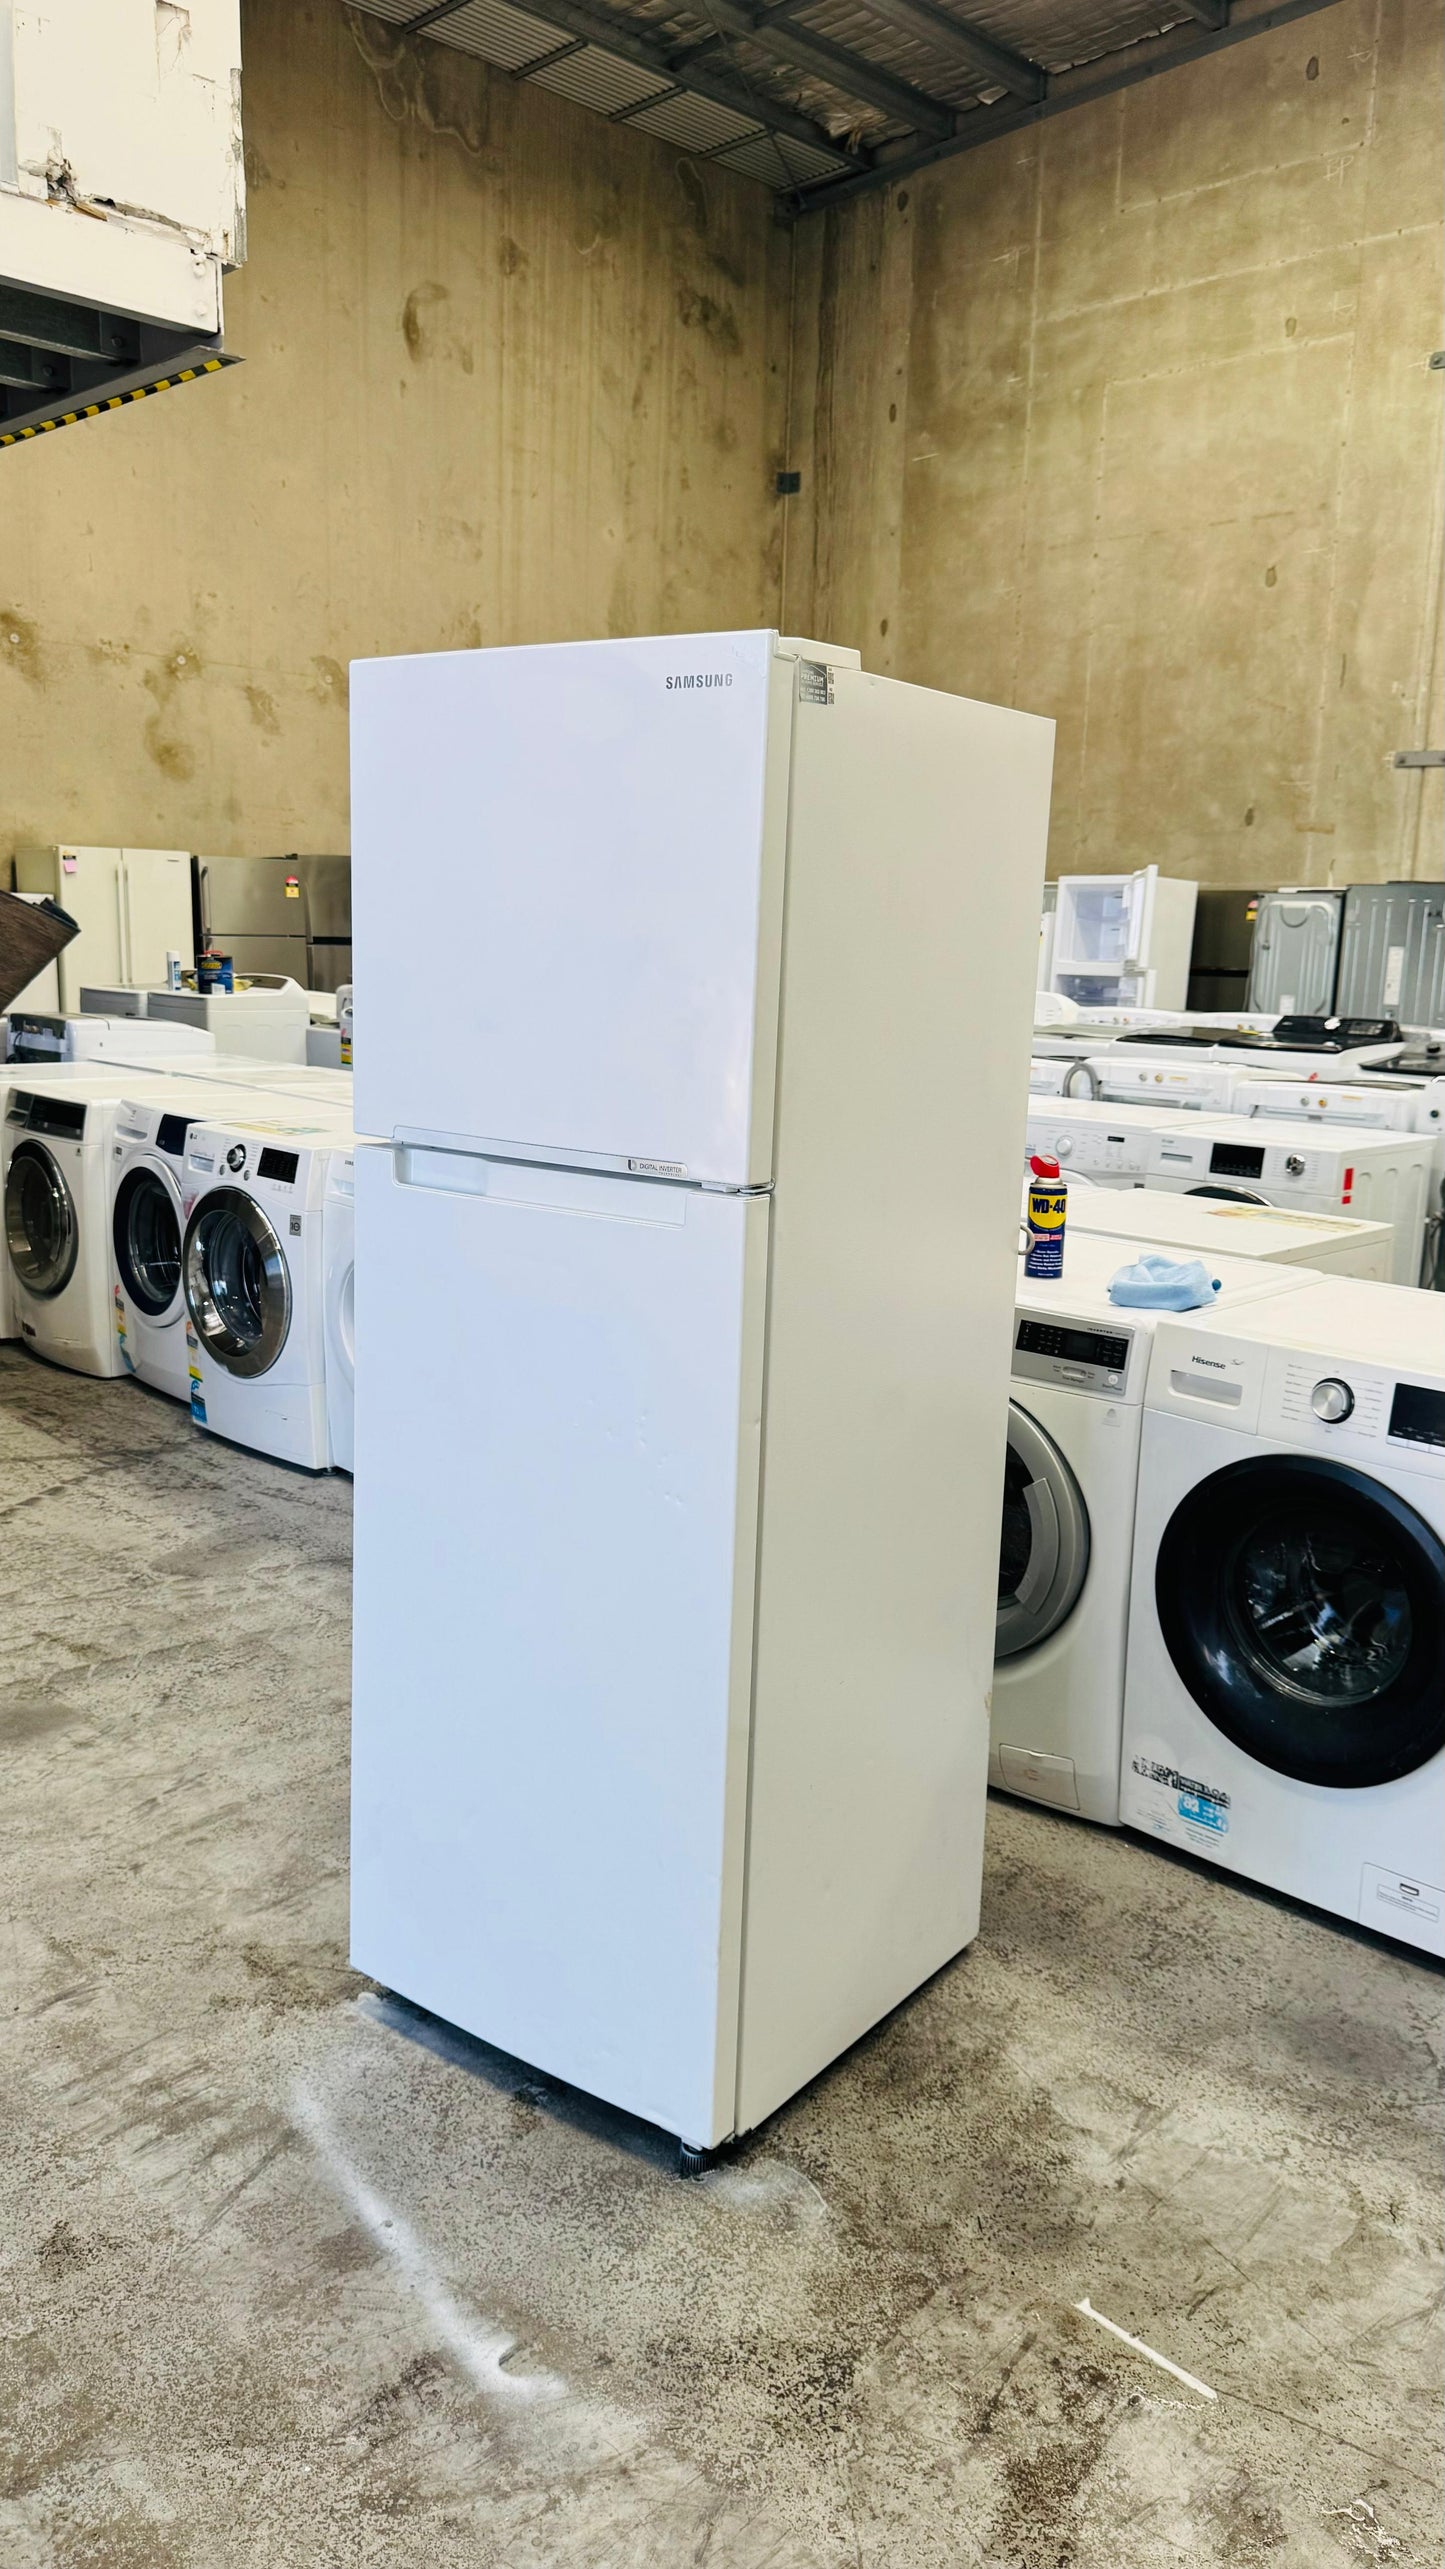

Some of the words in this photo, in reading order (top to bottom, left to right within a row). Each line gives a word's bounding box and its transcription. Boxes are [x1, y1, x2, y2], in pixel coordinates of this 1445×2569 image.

[666, 673, 733, 690] SAMSUNG
[640, 1163, 658, 1171] DIGITAL
[659, 1165, 682, 1174] INVERTER
[1032, 1197, 1066, 1214] WD-40
[1191, 1355, 1226, 1370] Hisense
